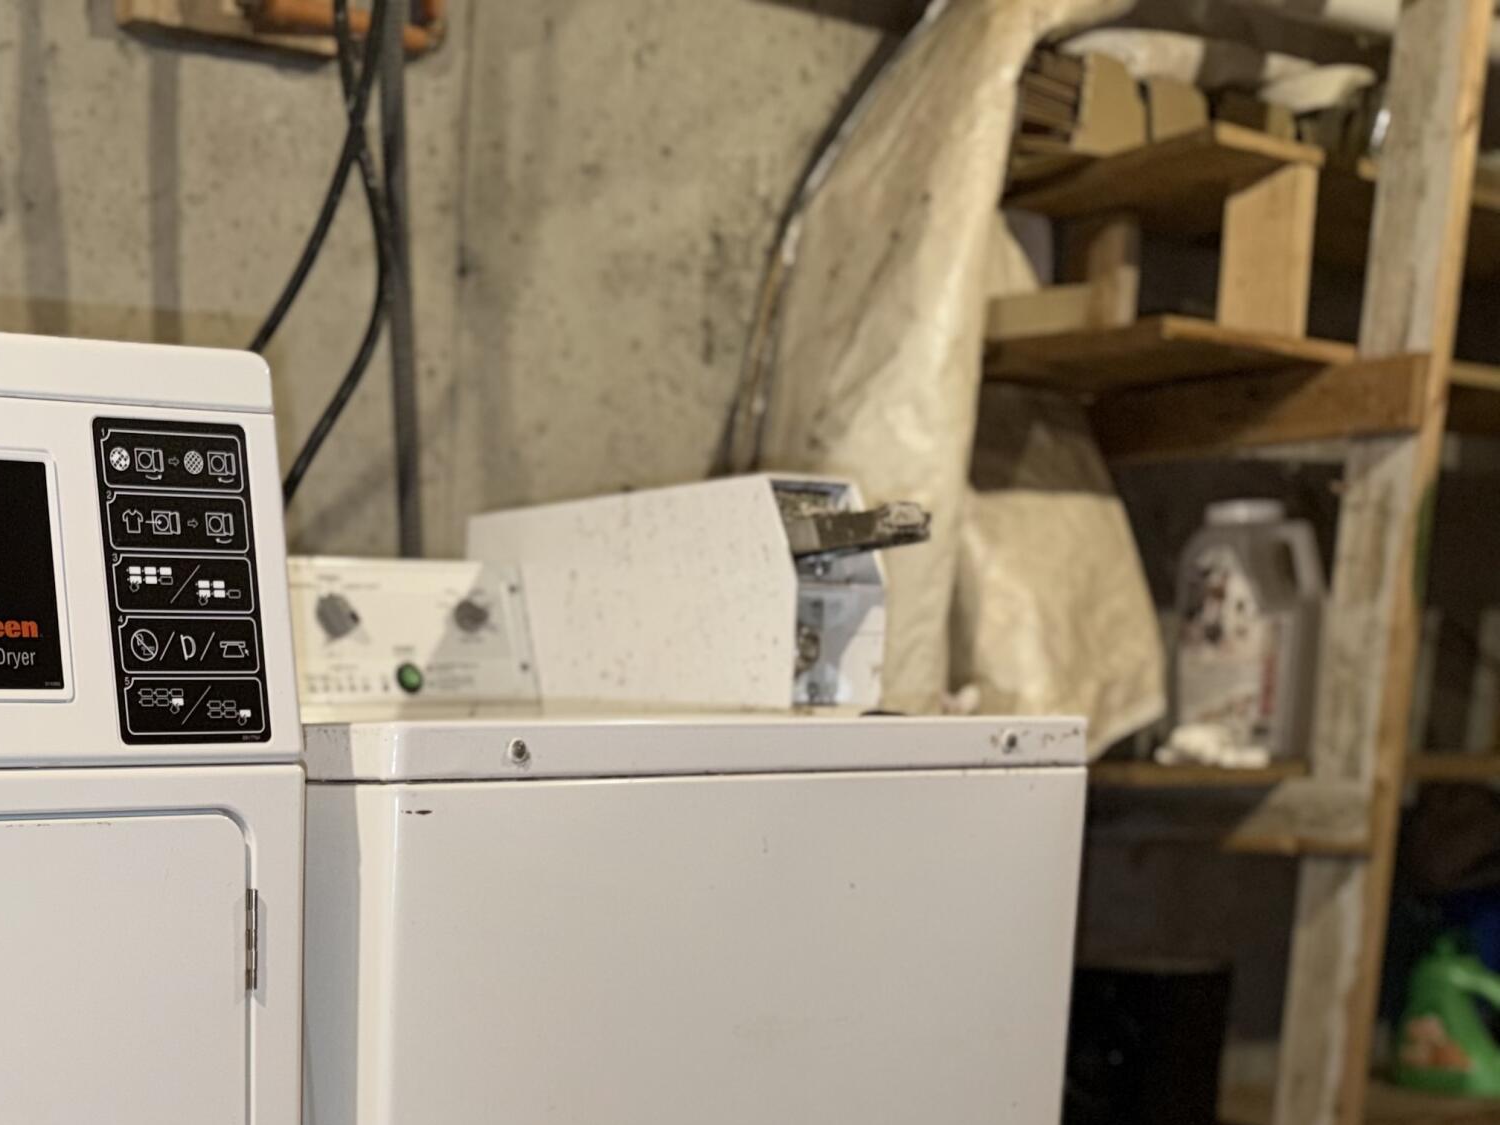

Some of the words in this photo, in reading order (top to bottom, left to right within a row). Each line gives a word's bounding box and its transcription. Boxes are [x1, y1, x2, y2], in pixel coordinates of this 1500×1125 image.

[106, 491, 112, 500] 2
[112, 554, 118, 562] 3
[118, 615, 124, 623] 4
[124, 677, 130, 686] 5
